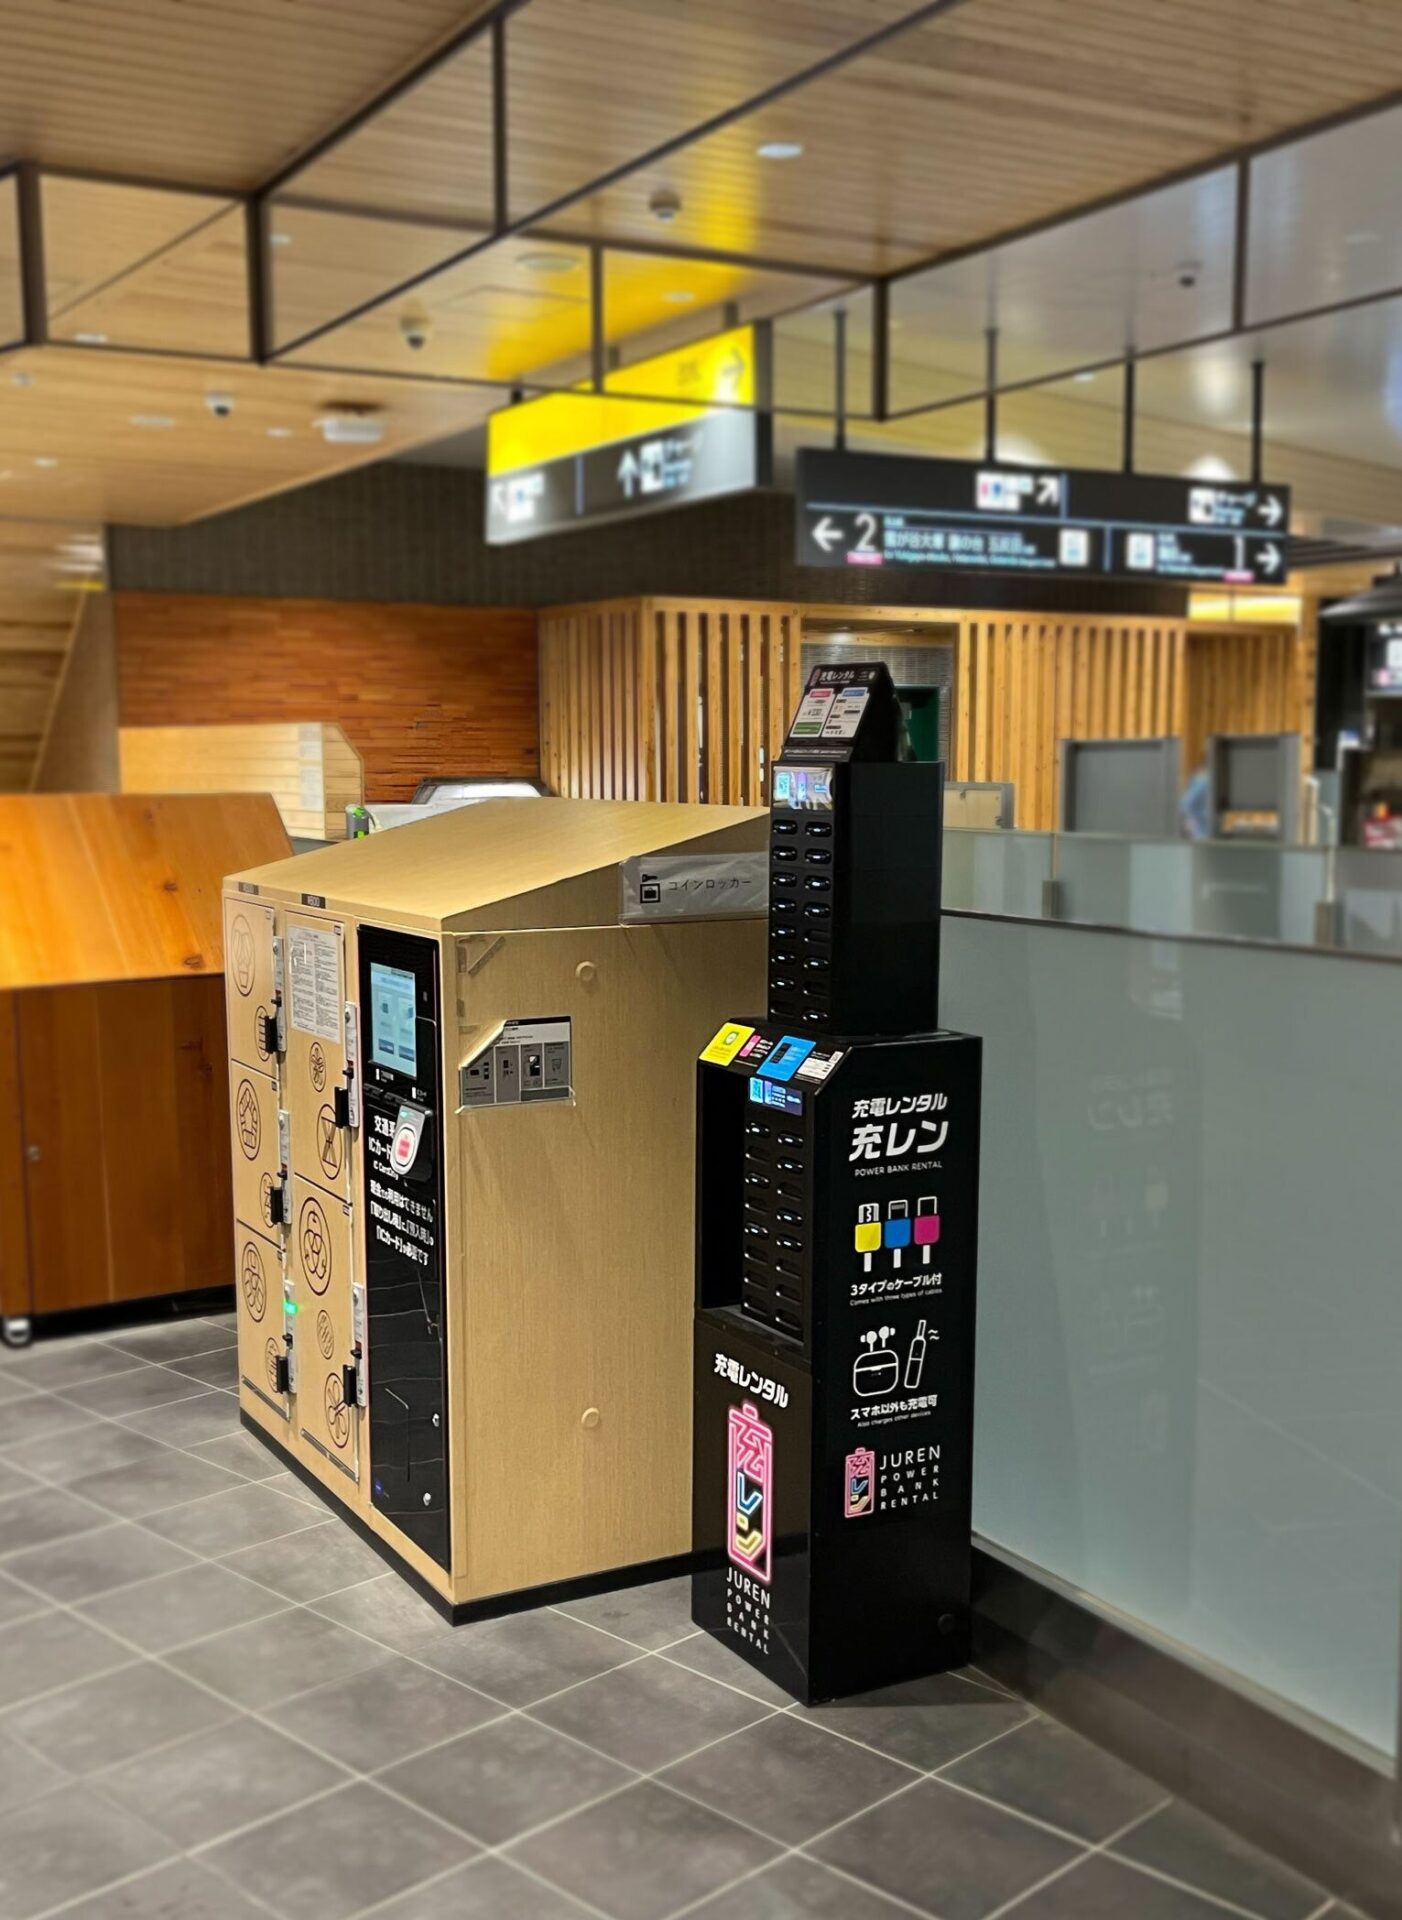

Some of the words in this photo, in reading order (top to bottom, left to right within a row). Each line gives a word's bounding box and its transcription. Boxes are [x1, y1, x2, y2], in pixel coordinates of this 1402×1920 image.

[854, 513, 877, 551] 2
[668, 877, 752, 891] コインロッカー
[851, 1093, 948, 1119] 充電レンタル
[849, 1120, 949, 1161] 充レン
[854, 1166, 885, 1177] POWER
[887, 1164, 909, 1174] BANK
[911, 1161, 943, 1171] RENTAL
[850, 1272, 942, 1296] 3タイプのケーブル付
[714, 1353, 789, 1408] 充電レンタル
[850, 1394, 938, 1420] スマホ以外も充電可
[879, 1444, 941, 1470] JUREN
[880, 1464, 940, 1484] POWER
[880, 1478, 940, 1497] BANK
[880, 1491, 940, 1510] RENTAL
[726, 1567, 770, 1609] JUREN
[727, 1588, 769, 1625] POWER
[727, 1602, 769, 1640] BANK
[727, 1616, 769, 1655] RENTAL
